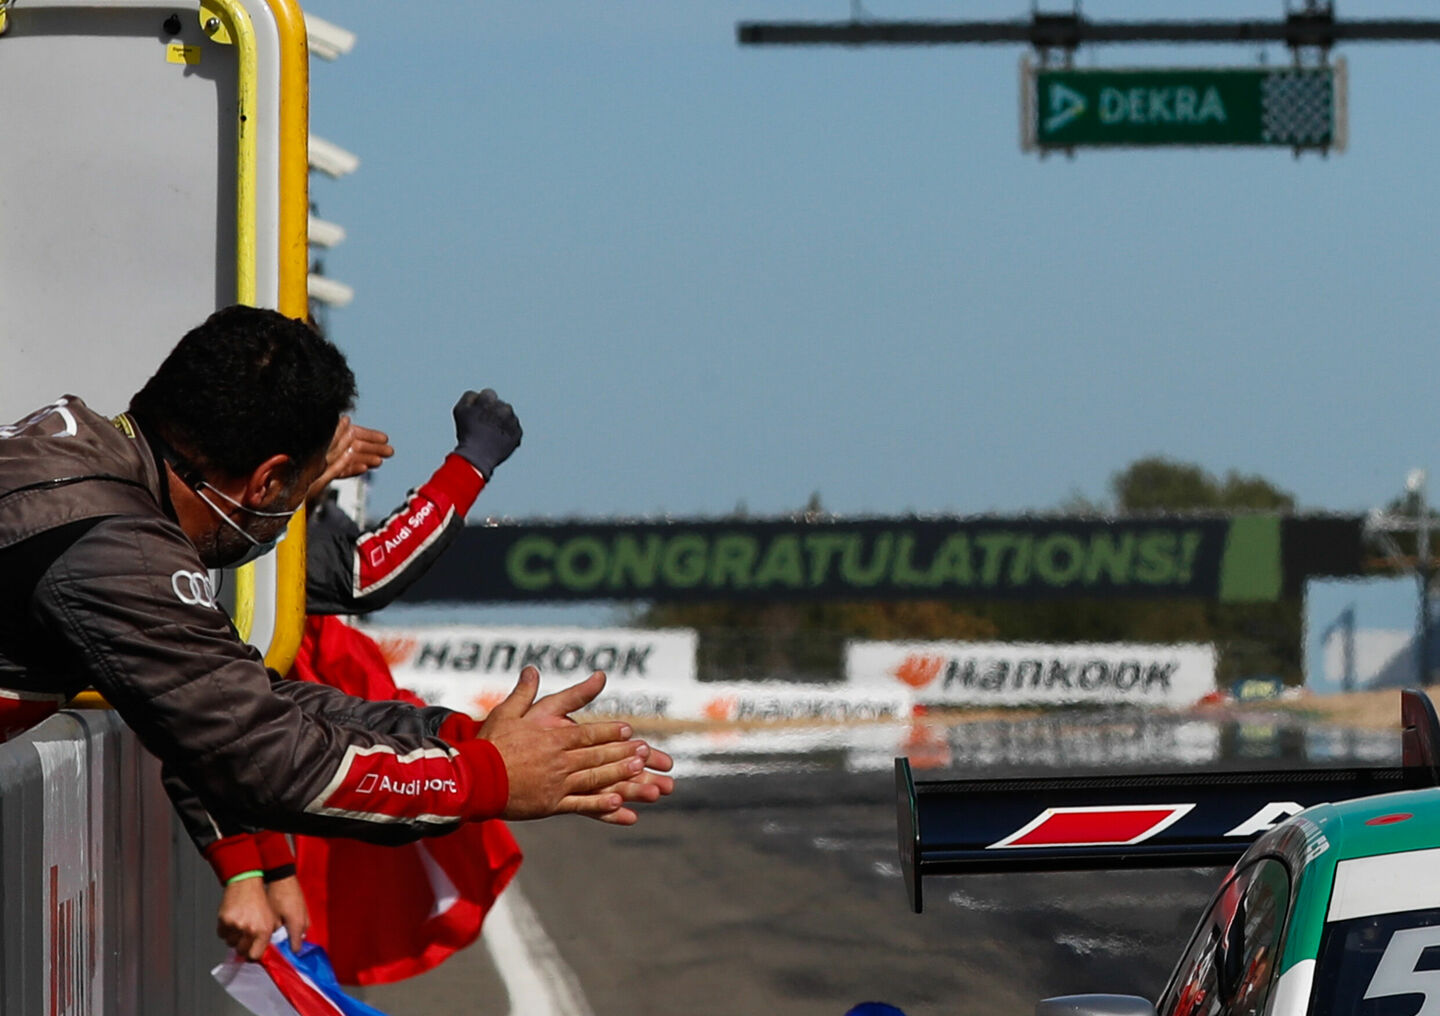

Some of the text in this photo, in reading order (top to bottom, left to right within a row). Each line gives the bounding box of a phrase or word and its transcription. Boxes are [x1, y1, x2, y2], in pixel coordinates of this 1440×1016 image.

[1099, 85, 1228, 123] DEKRA
[384, 526, 412, 553] Audi
[506, 533, 1200, 590] CONGRATULATIONS!
[379, 776, 420, 795] Audi
